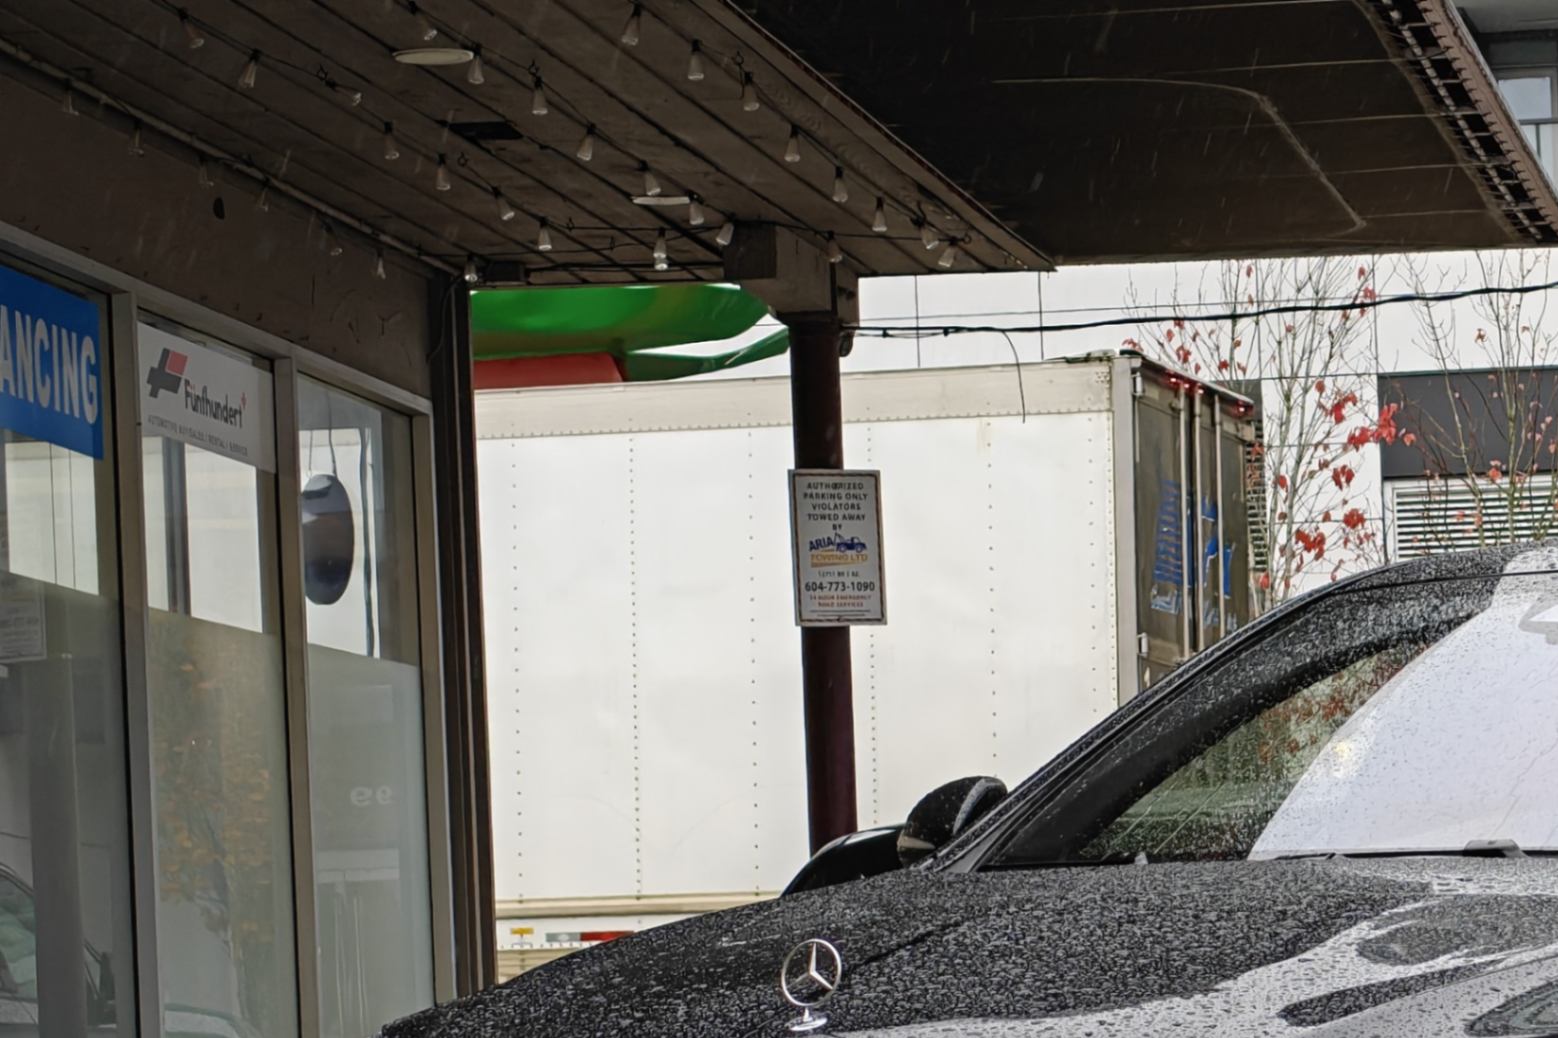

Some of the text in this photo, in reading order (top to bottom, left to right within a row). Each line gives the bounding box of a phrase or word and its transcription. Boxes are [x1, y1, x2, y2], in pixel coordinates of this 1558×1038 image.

[0, 304, 98, 425] ANCING
[807, 482, 864, 490] AUTHORIZED
[803, 492, 868, 501] PARKING ONLY
[811, 502, 861, 511] VIOLATORS
[807, 513, 866, 521] TOWED AWAY
[832, 523, 842, 531] BY
[809, 536, 834, 552] ARIA
[805, 581, 875, 592] 604-773-1090
